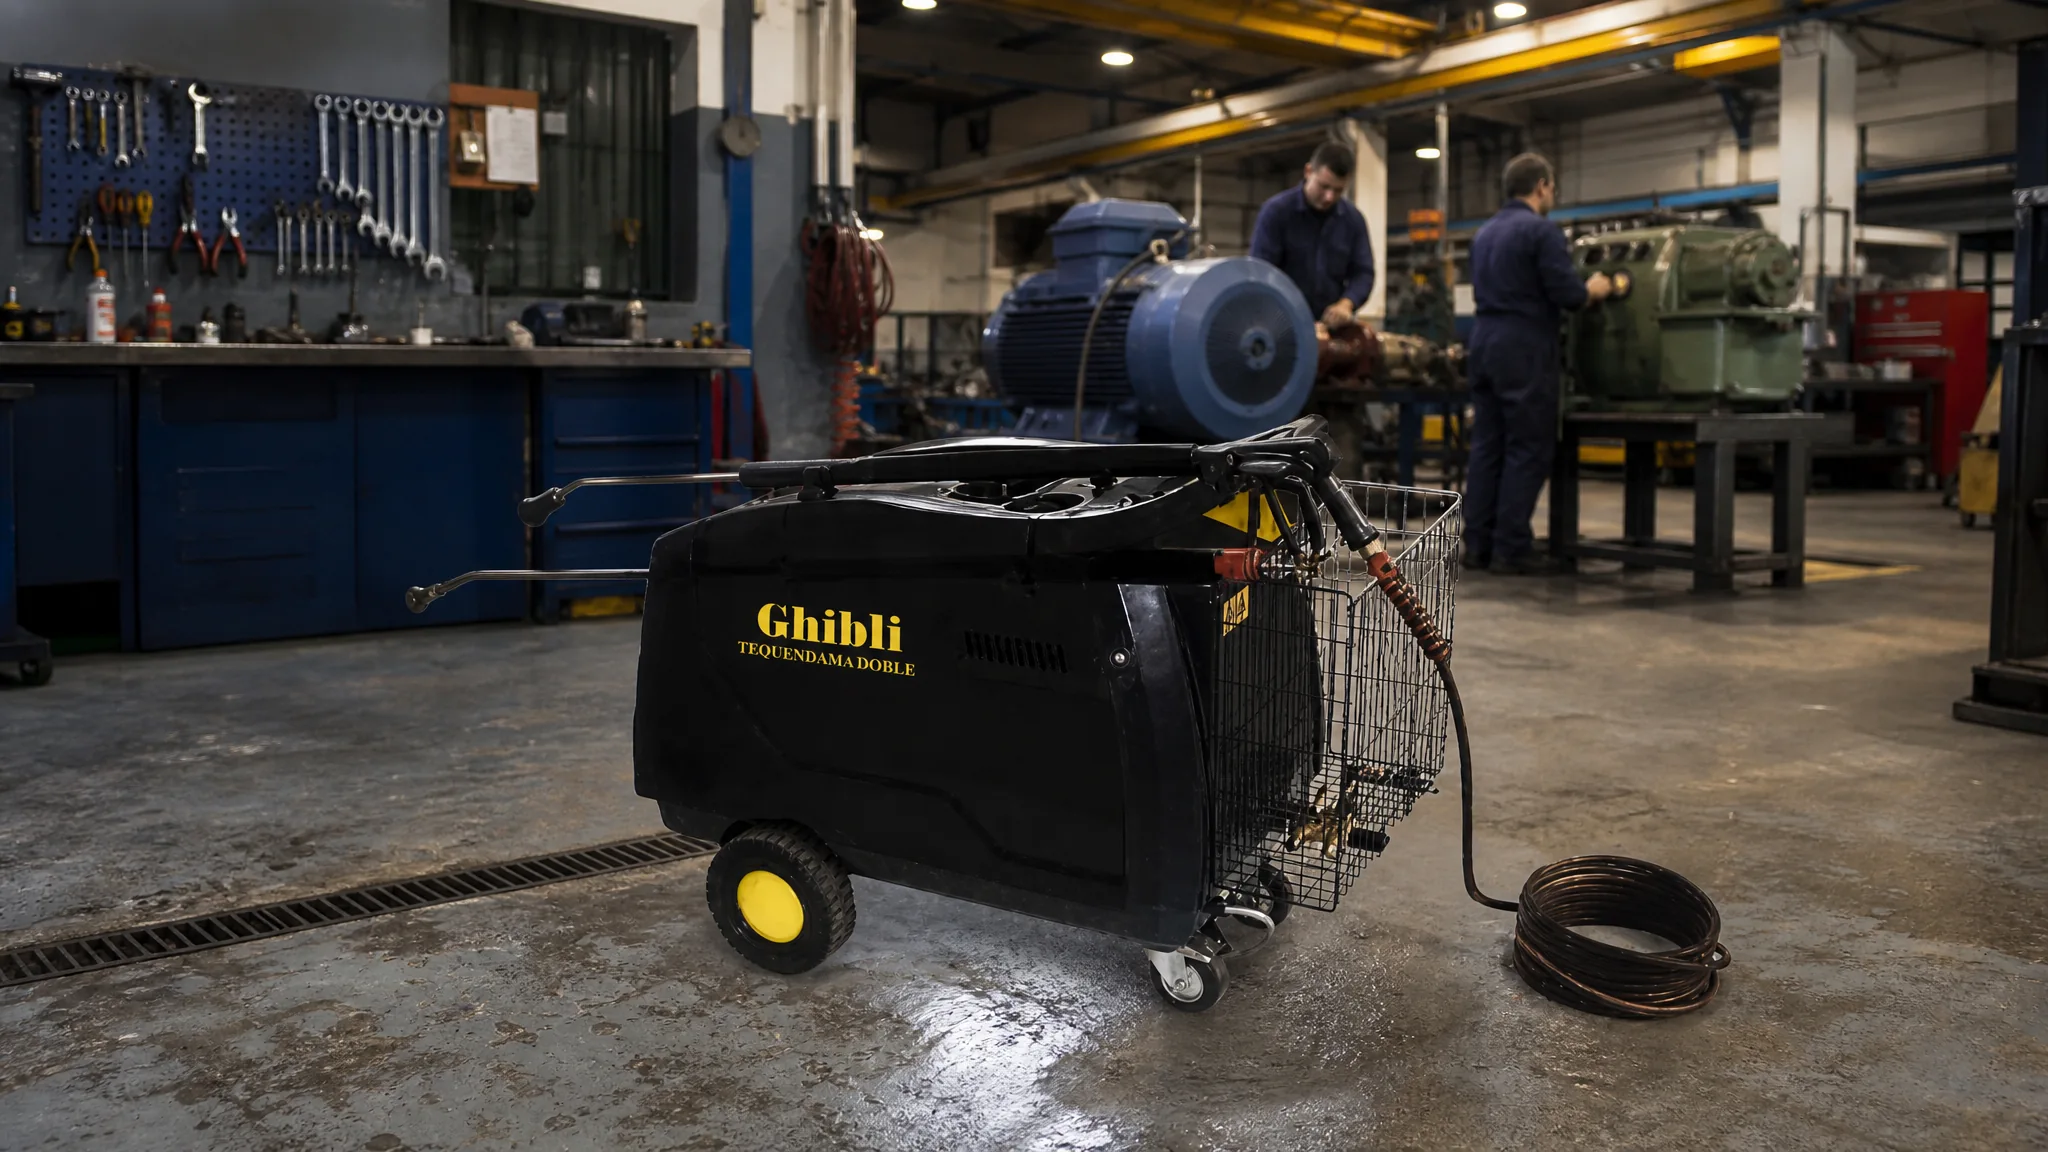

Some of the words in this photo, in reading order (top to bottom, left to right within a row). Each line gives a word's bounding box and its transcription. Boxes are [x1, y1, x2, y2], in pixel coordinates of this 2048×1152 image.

[757, 602, 903, 653] Ghibli
[737, 640, 854, 668] TEQUENDAMA
[856, 656, 916, 677] DOBLE
